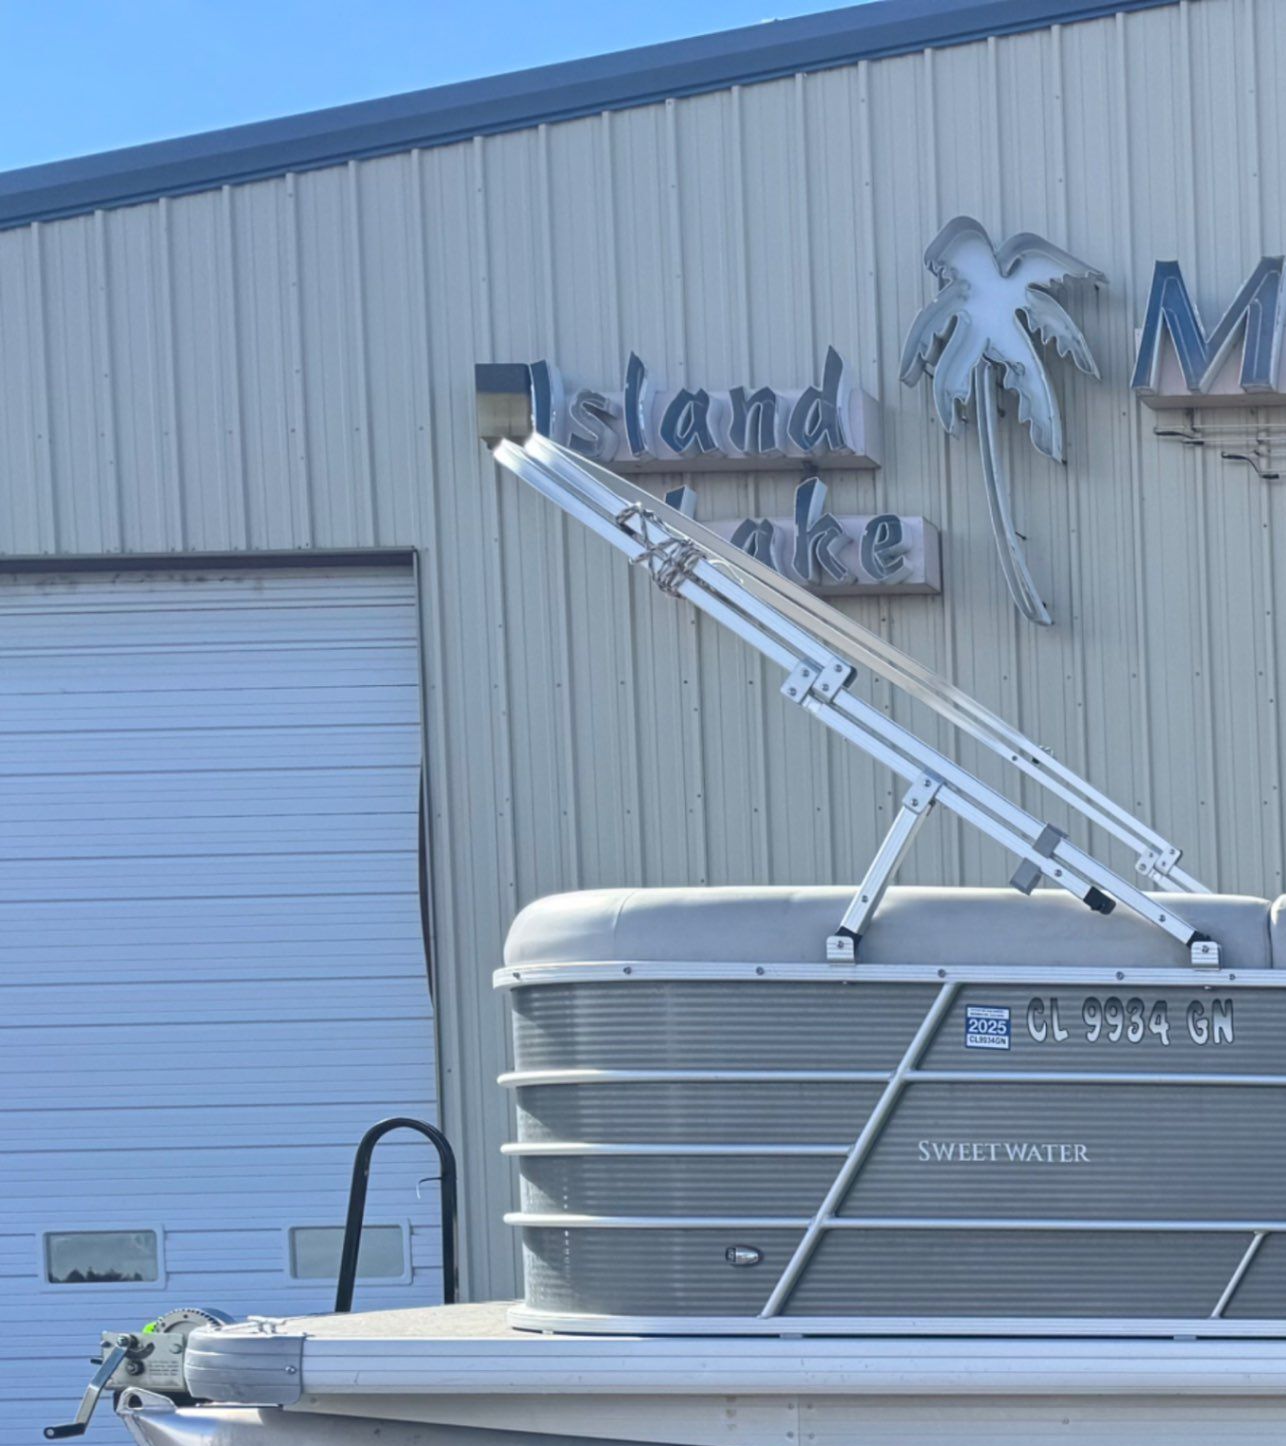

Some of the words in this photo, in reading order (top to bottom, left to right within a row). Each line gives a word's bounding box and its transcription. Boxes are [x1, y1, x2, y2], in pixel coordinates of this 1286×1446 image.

[529, 344, 862, 460] Island
[664, 476, 907, 584] ake
[968, 1018, 1008, 1035] 2025
[1026, 996, 1069, 1043] CL
[1081, 996, 1171, 1046] 9934
[1185, 998, 1236, 1045] GN
